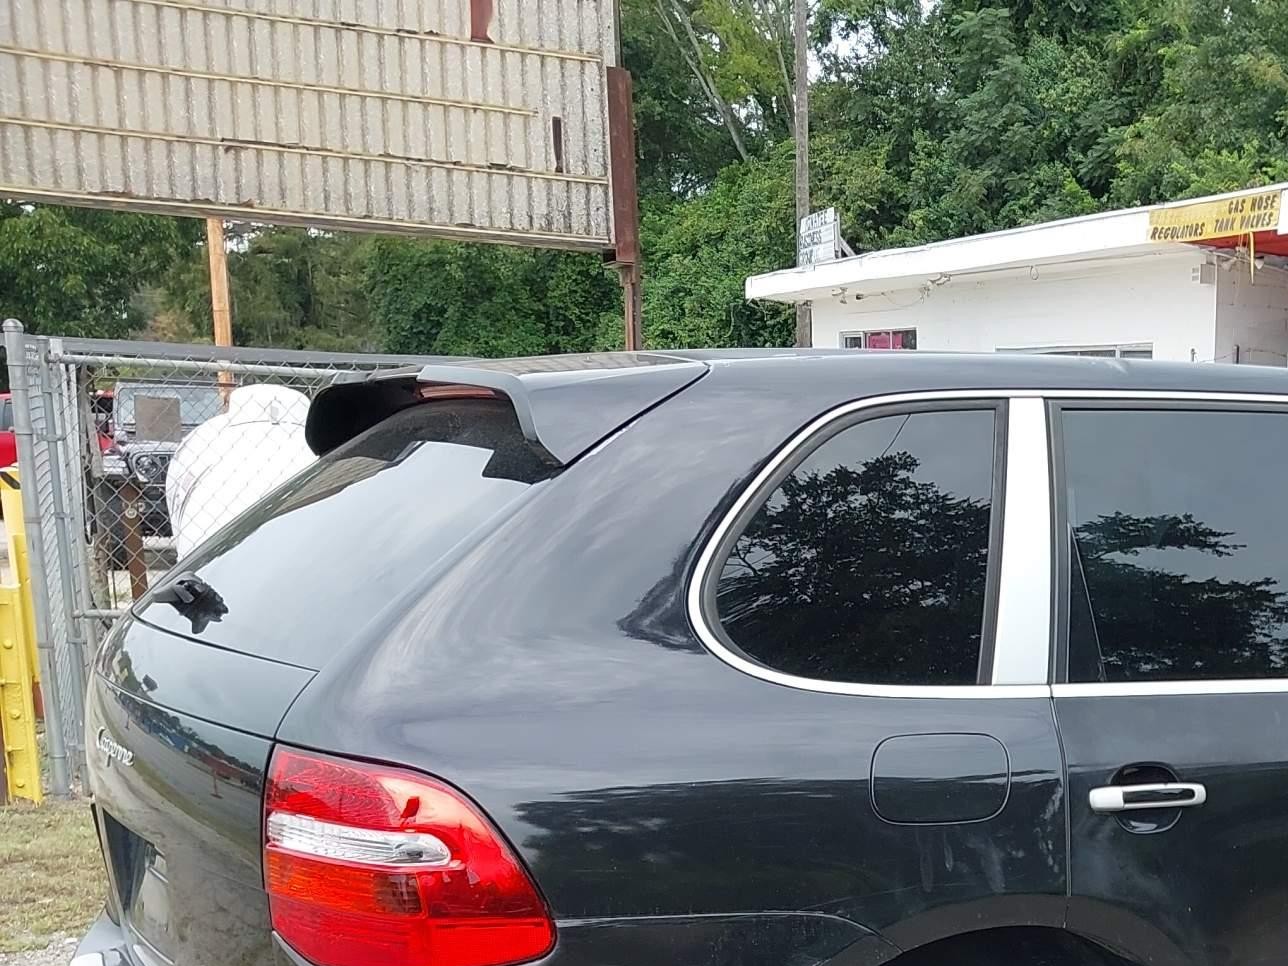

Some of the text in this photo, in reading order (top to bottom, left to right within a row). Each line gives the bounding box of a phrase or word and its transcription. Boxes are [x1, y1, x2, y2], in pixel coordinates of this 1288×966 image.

[1228, 195, 1277, 215] GAS HOSE
[1150, 212, 1273, 240] REGULATORS TANK VALVES
[96, 726, 135, 768] Cayenne
